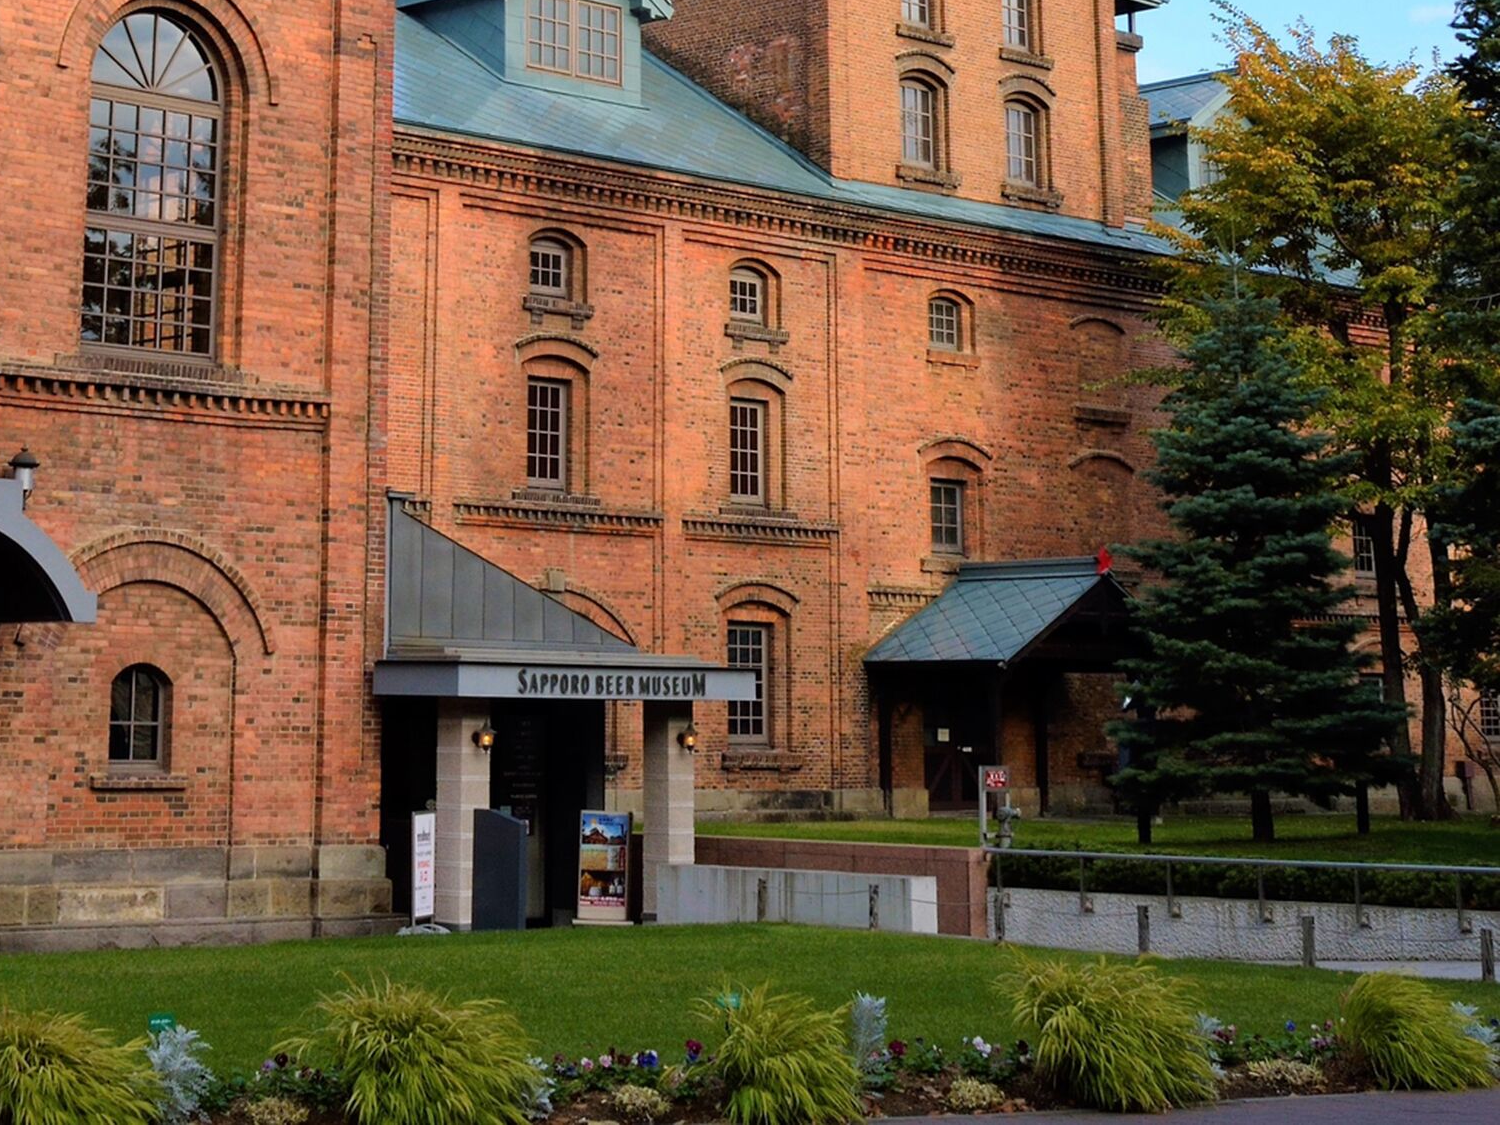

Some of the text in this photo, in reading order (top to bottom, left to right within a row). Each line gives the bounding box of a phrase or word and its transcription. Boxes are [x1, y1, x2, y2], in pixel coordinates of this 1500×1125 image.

[517, 667, 706, 697] SAPPORO BEER MUSEUM
